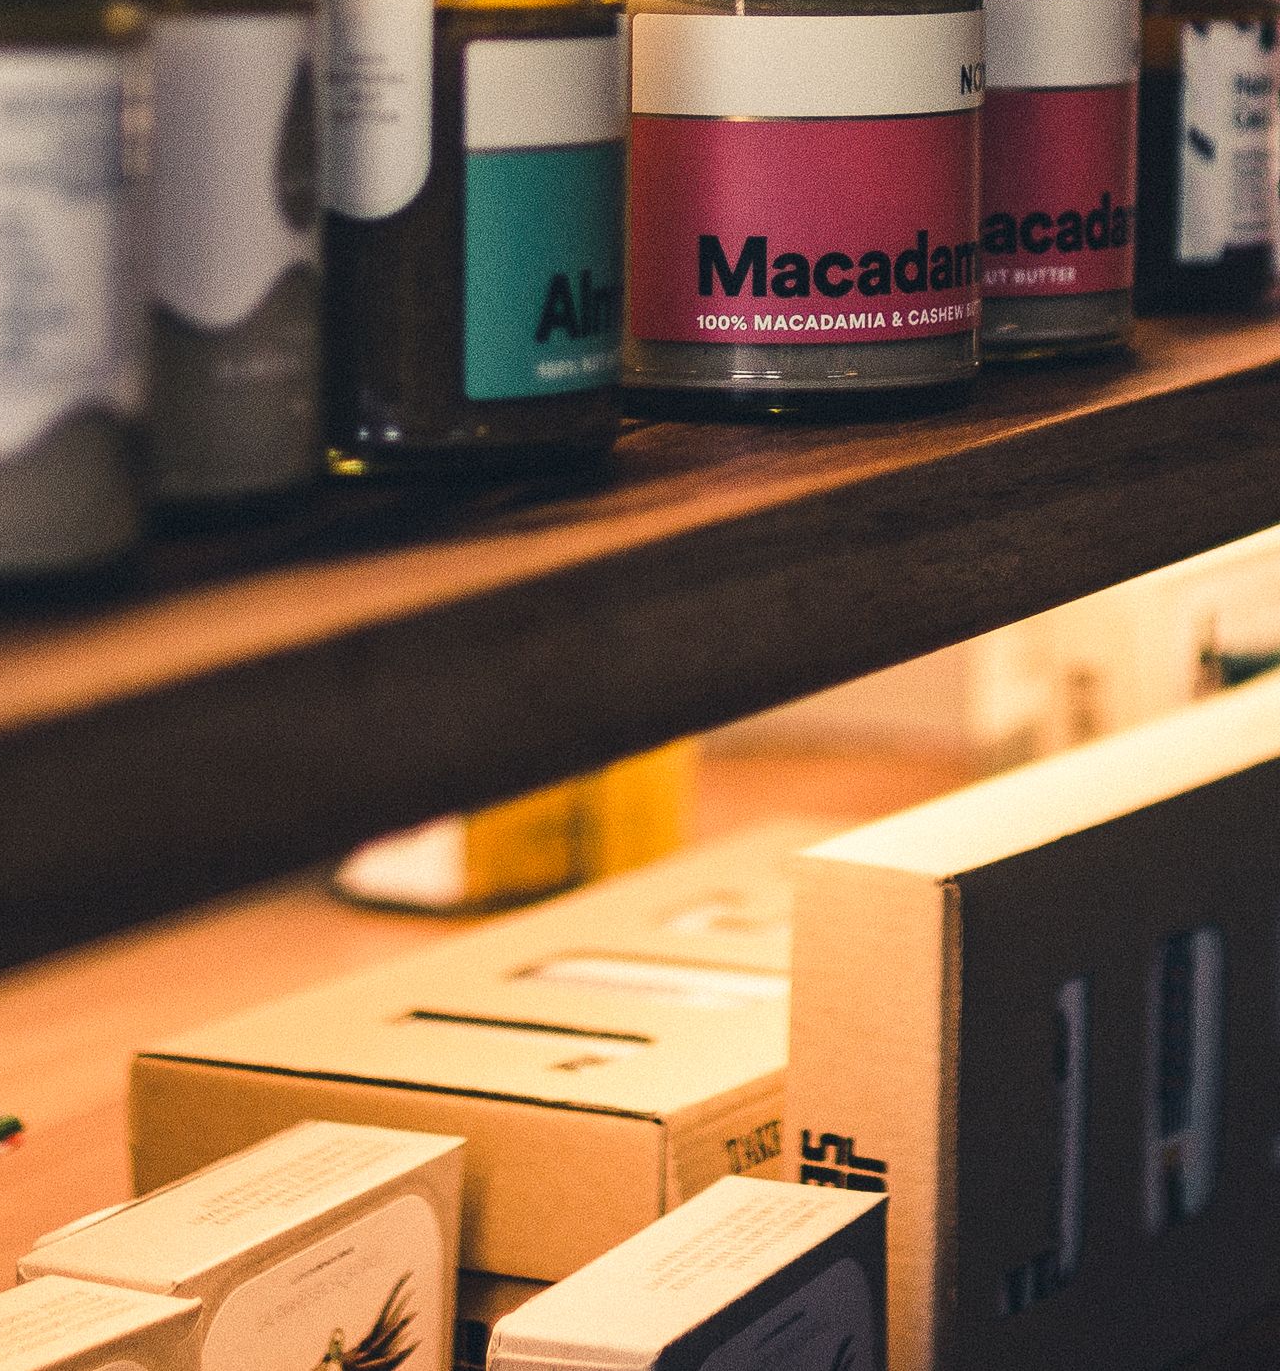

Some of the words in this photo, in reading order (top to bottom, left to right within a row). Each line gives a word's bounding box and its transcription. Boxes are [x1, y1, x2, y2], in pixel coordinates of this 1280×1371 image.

[960, 62, 986, 96] NO
[981, 191, 1129, 256] acada
[984, 268, 1009, 285] UT
[1013, 265, 1077, 285] BUTTER
[696, 314, 748, 331] 100%
[753, 312, 887, 332] MACADAMIA
[891, 313, 904, 328] &
[907, 302, 965, 326] CASHEW
